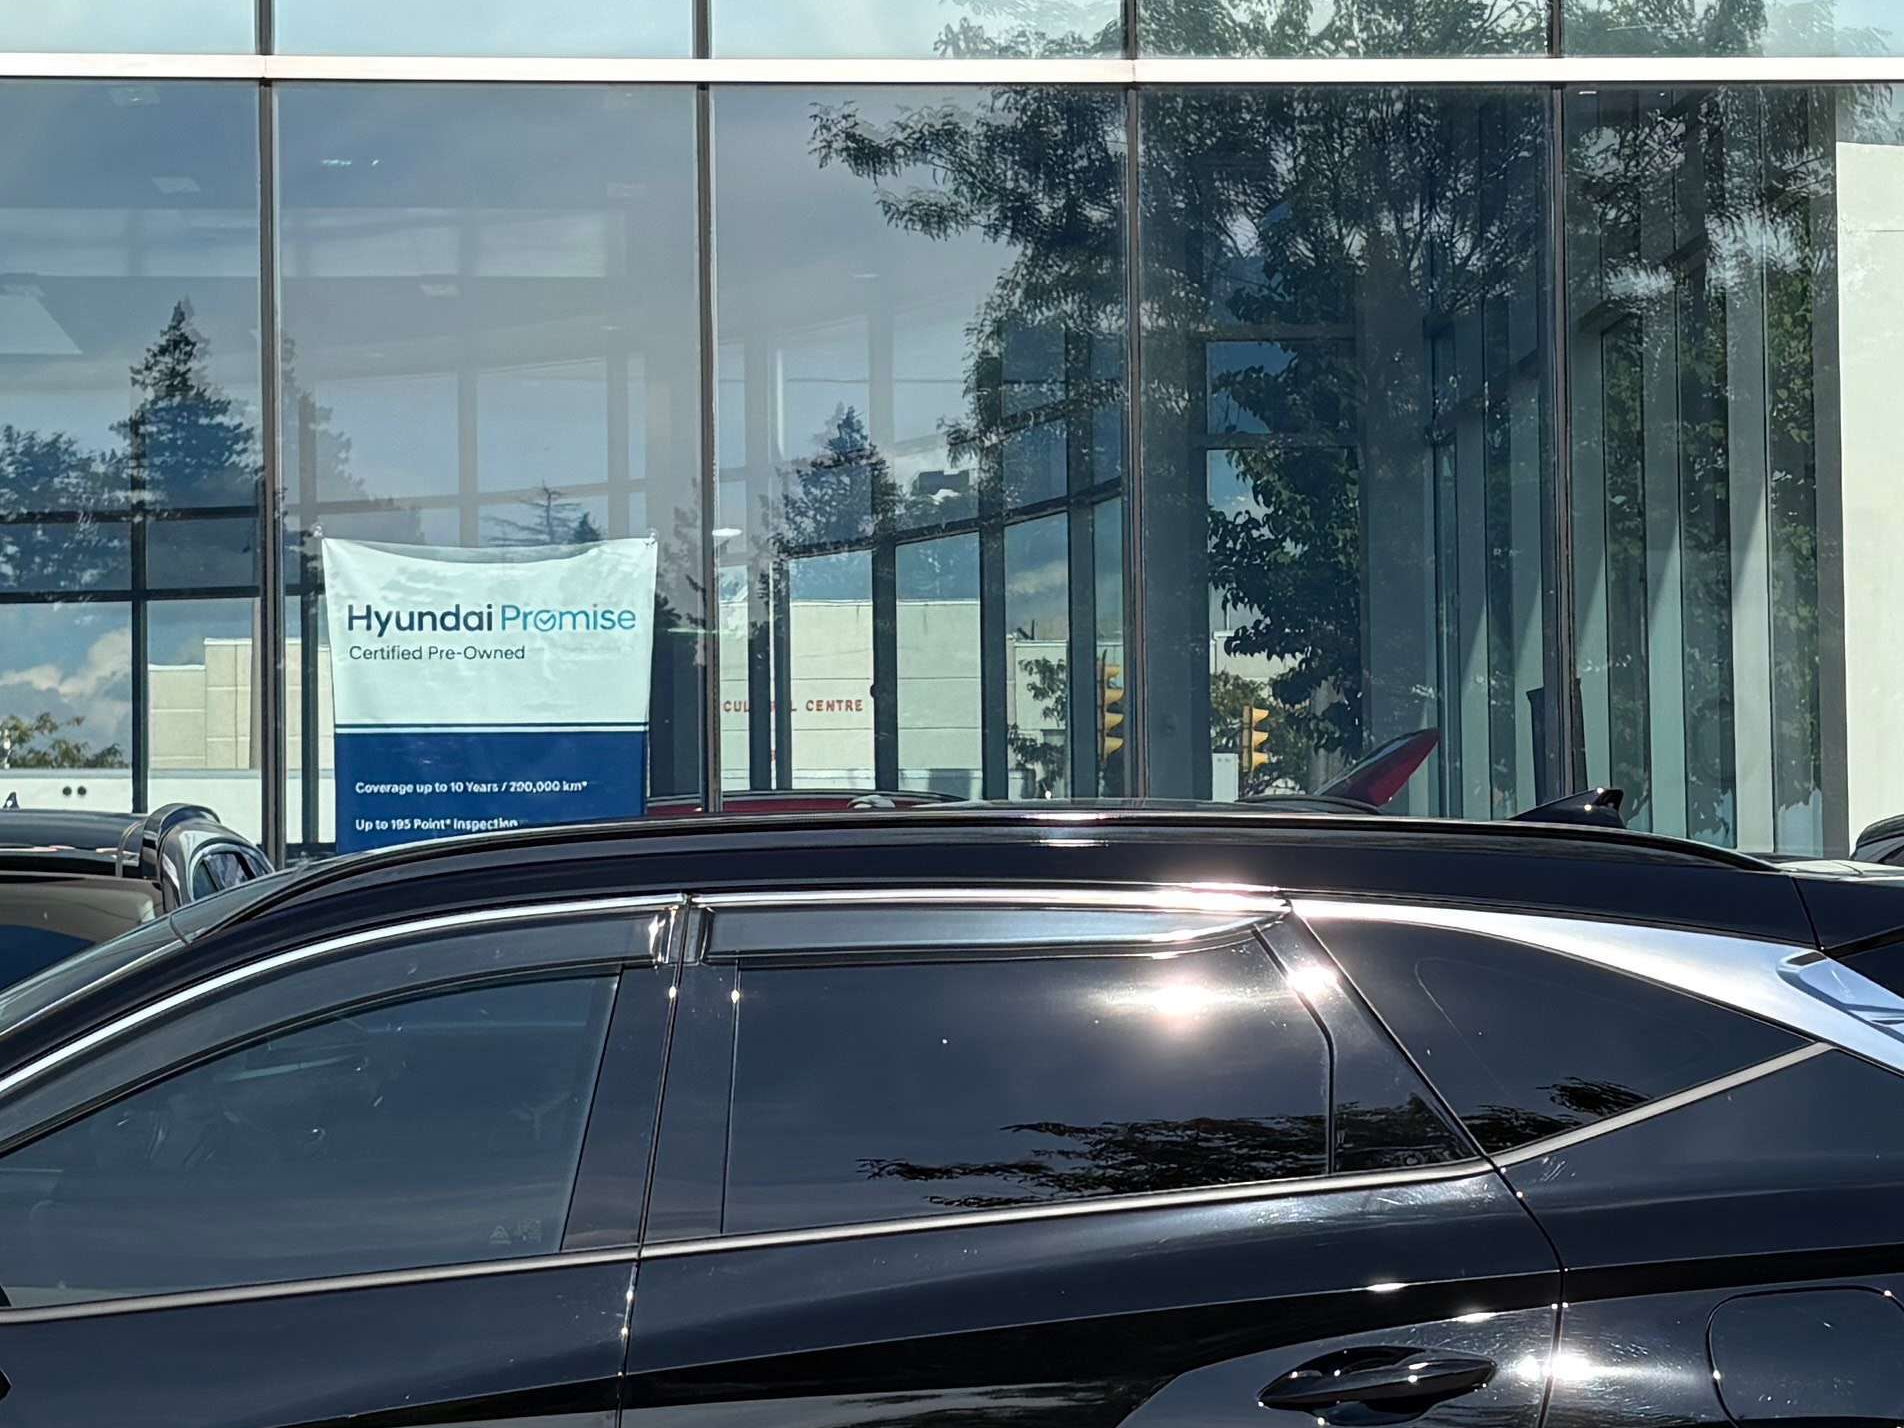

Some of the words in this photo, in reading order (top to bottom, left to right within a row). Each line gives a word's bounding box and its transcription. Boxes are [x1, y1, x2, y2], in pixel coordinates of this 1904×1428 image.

[347, 604, 493, 638] Hyundai
[501, 604, 637, 632] Promise
[349, 646, 423, 660] Certified
[429, 646, 526, 660] Pre-Owned
[805, 699, 863, 712] CENTRE
[355, 781, 415, 795] Coverage
[416, 784, 434, 794] up
[435, 782, 448, 793] to
[451, 782, 464, 792] 10
[466, 781, 499, 793] Years
[509, 781, 562, 793] 200,000
[355, 819, 373, 830] Up
[375, 819, 388, 829] to
[391, 819, 412, 830] 195
[453, 818, 519, 831] Inspection
